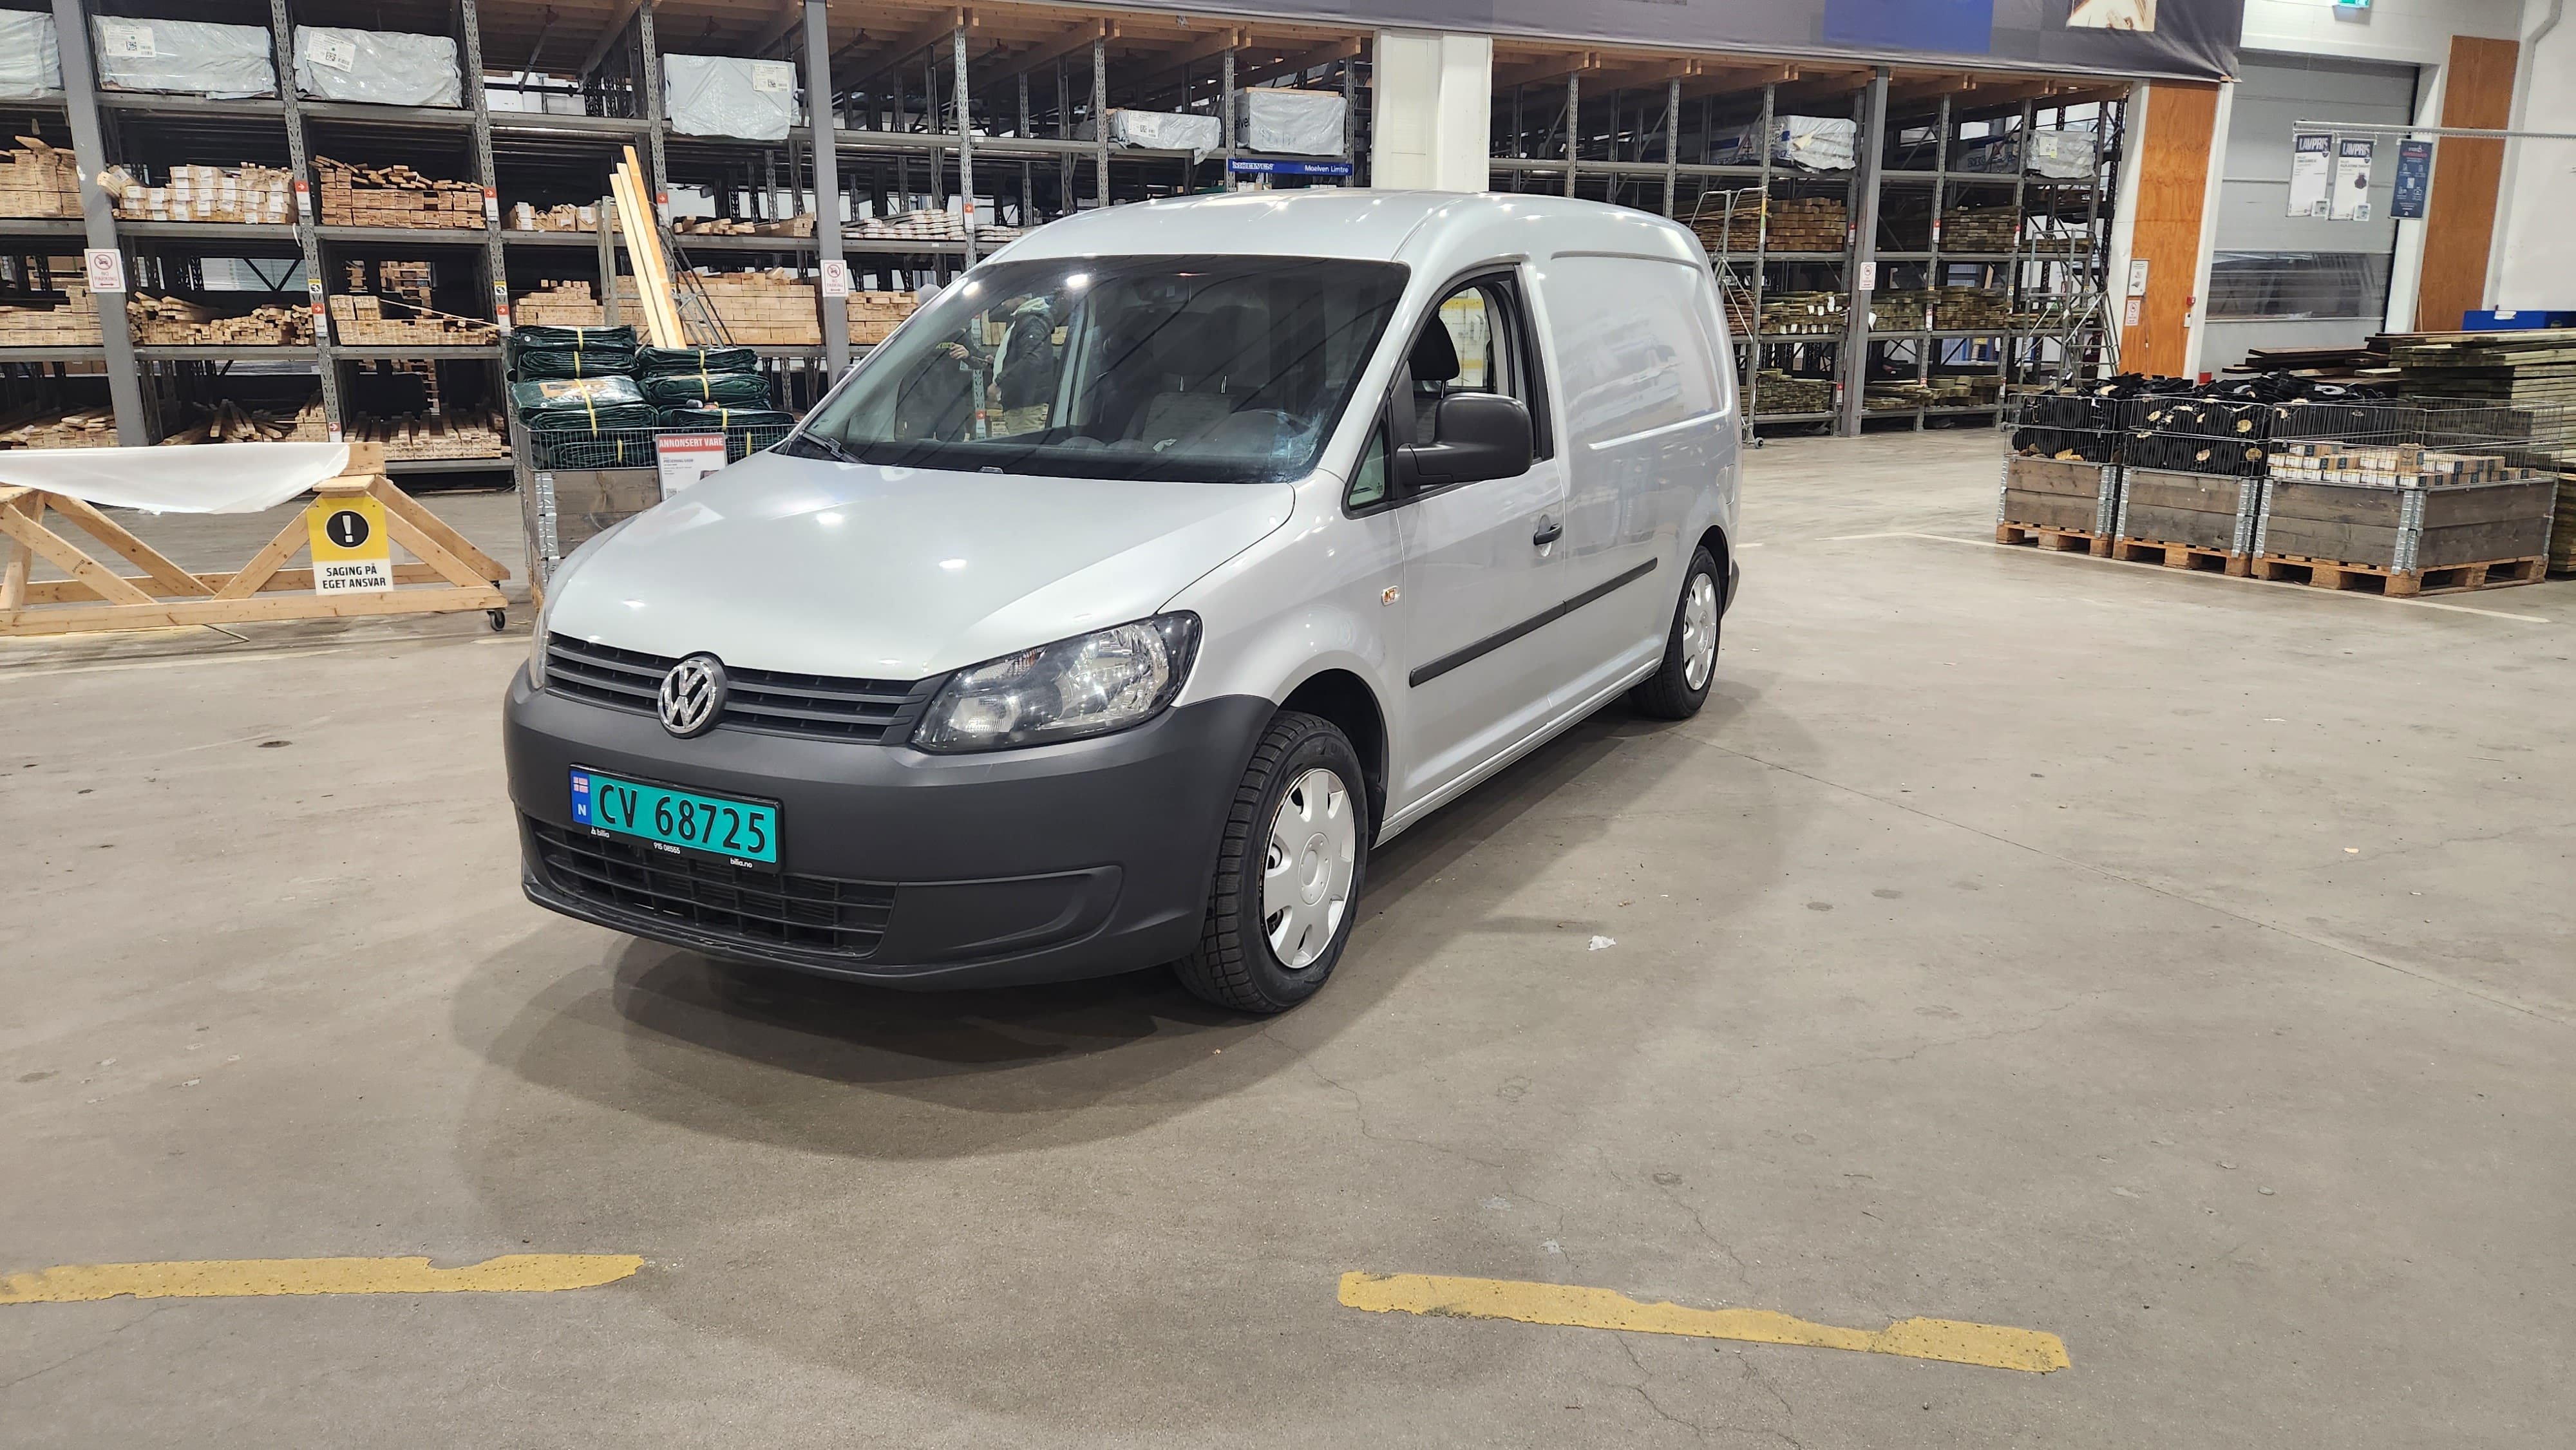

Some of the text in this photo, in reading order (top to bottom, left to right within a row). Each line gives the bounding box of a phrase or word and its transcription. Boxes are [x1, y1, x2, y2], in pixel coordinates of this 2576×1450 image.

[2298, 137, 2329, 151] LAVPRIS
[2342, 142, 2371, 156] LAVPRIS
[1232, 161, 1275, 171] MOELVEN
[1304, 164, 1329, 173] Moelven
[659, 437, 724, 448] ANNONSERT VARE
[326, 562, 377, 577] SAGING PÅ
[323, 577, 386, 589] EGET ANSVAR
[578, 803, 587, 816] N
[599, 784, 766, 854] CV 68725
[596, 828, 610, 838] bilia
[653, 842, 663, 850] 915
[730, 857, 753, 868] bilia.no
